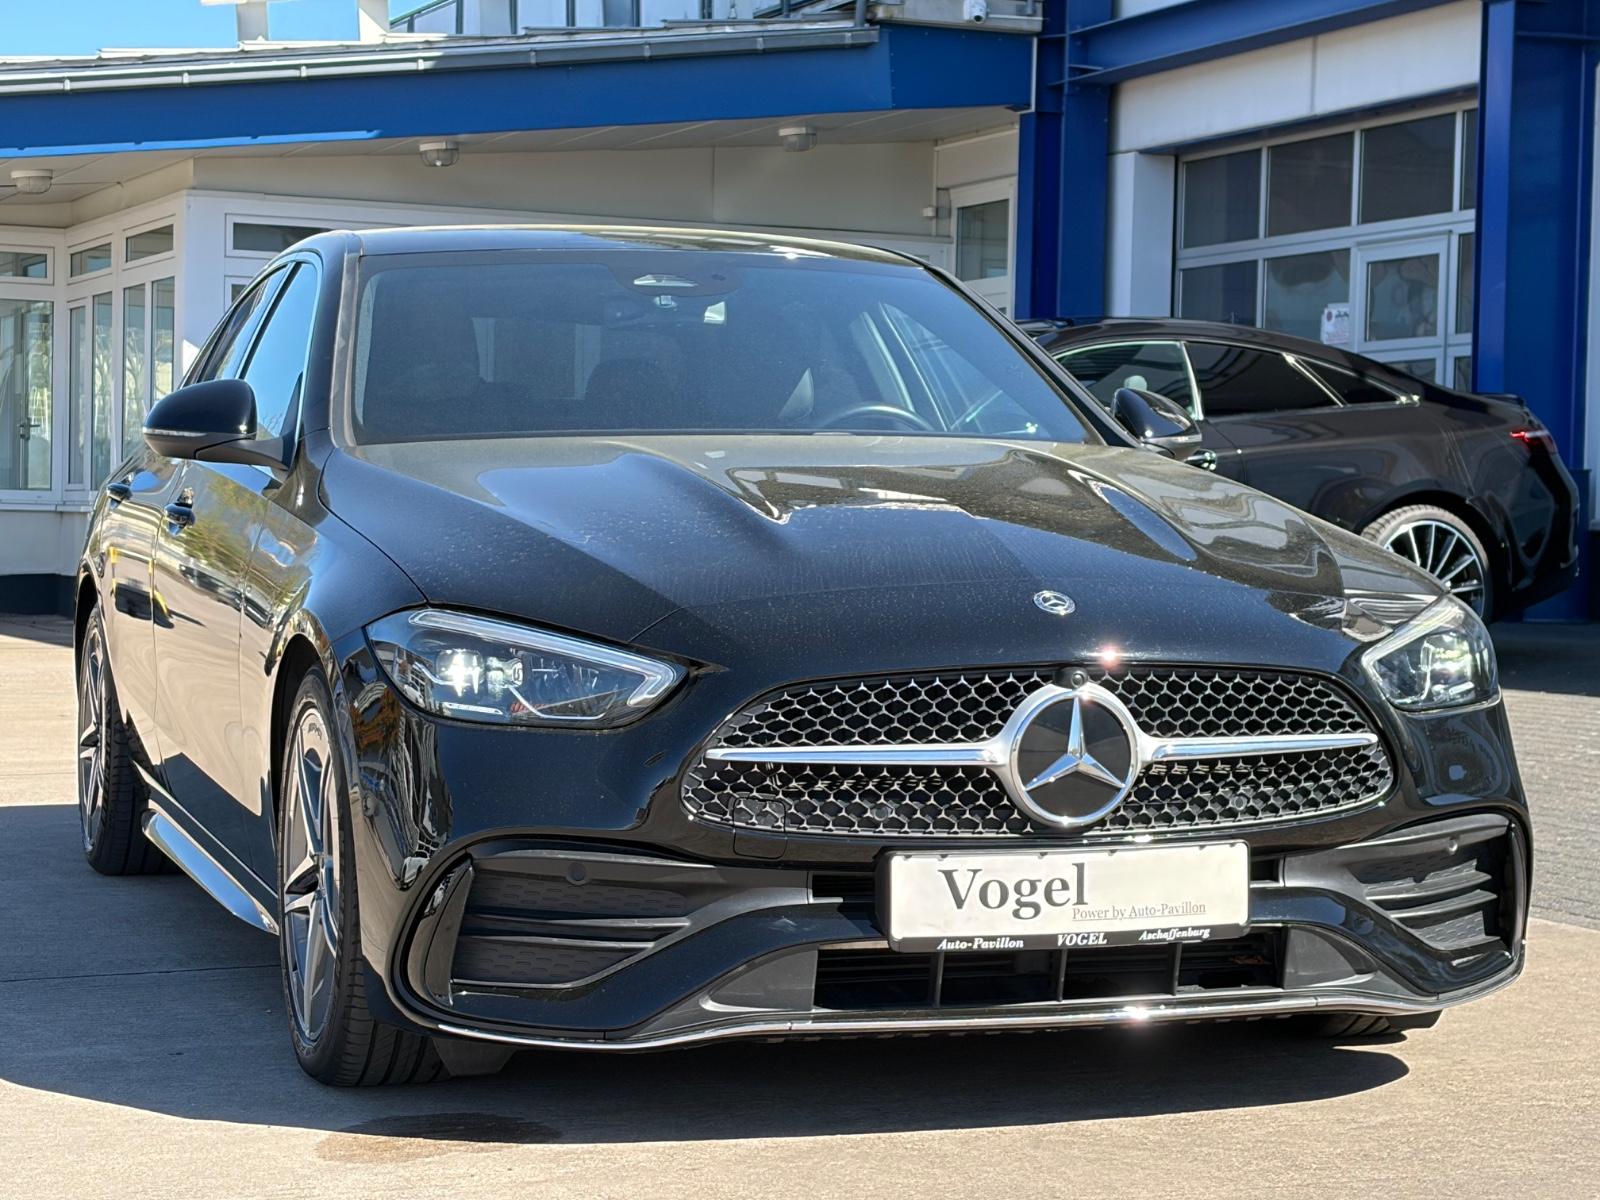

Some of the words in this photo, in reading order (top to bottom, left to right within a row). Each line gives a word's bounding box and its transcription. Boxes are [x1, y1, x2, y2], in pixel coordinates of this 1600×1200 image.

[937, 862, 1088, 920] Vogel
[1073, 907, 1110, 919] Power
[1112, 905, 1127, 920] by
[1129, 901, 1207, 917] Auto-Pavillon
[937, 937, 1025, 950] Auto-Pavillon
[1057, 933, 1108, 947] VOGEL
[1138, 927, 1211, 941] Aschaffenburg
